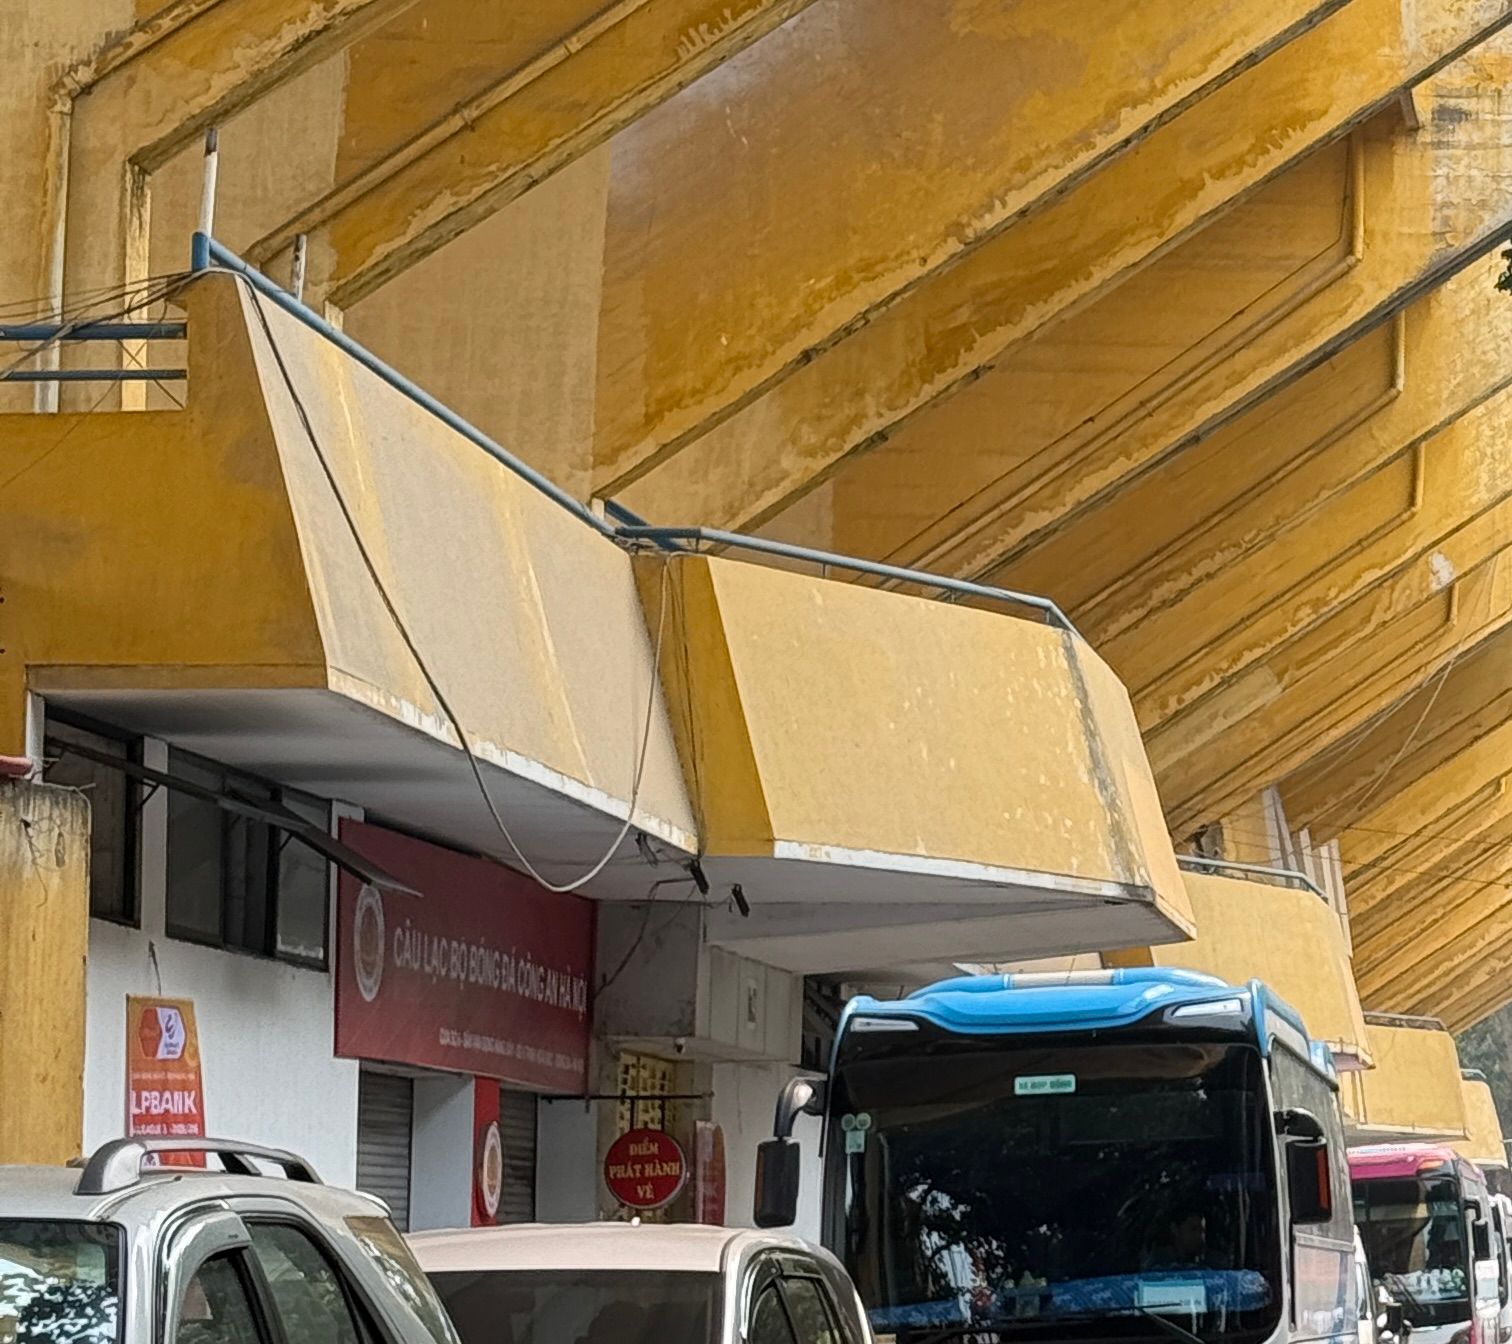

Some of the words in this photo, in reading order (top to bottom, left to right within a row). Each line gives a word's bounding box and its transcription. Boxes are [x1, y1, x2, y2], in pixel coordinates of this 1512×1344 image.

[423, 931, 449, 984] LẠC
[451, 937, 468, 991] BỘ
[469, 936, 500, 989] BÓNG
[517, 951, 544, 1002] CÔNG
[544, 967, 558, 1005] AN
[629, 1137, 659, 1156] ĐIỂM
[609, 1160, 641, 1179] PHÁT
[644, 1159, 680, 1176] HÀNH
